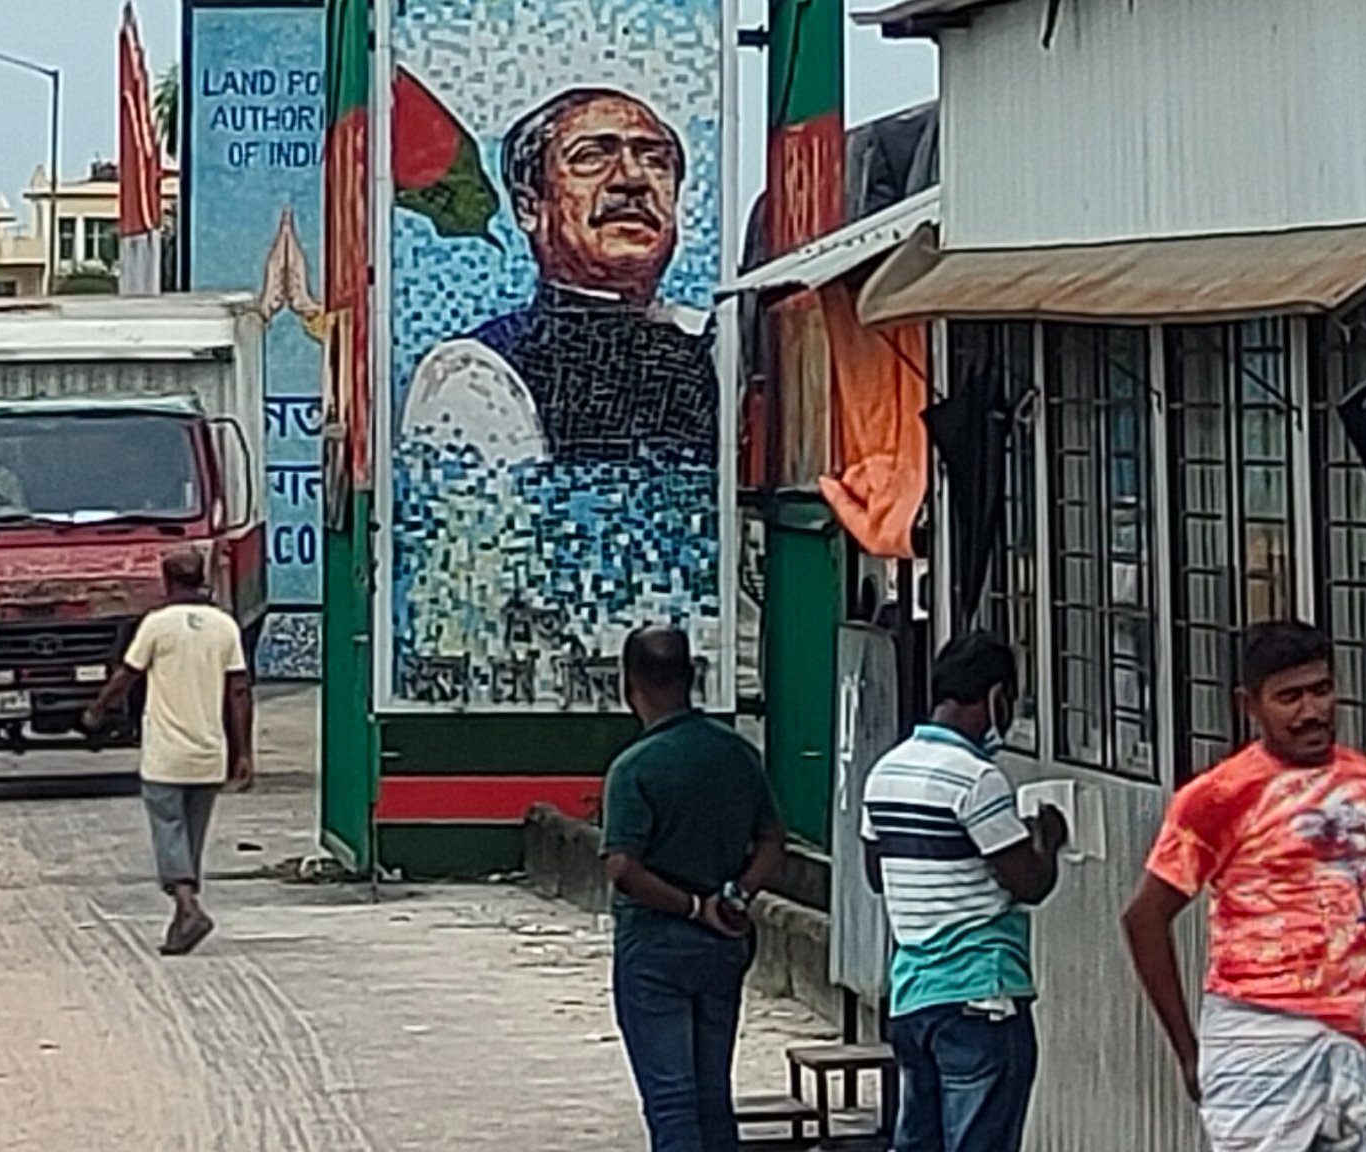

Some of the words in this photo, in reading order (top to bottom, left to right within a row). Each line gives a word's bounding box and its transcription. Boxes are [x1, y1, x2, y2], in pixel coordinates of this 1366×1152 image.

[202, 68, 276, 97] LAND
[228, 141, 260, 168] OF
[269, 141, 325, 168] INDI
